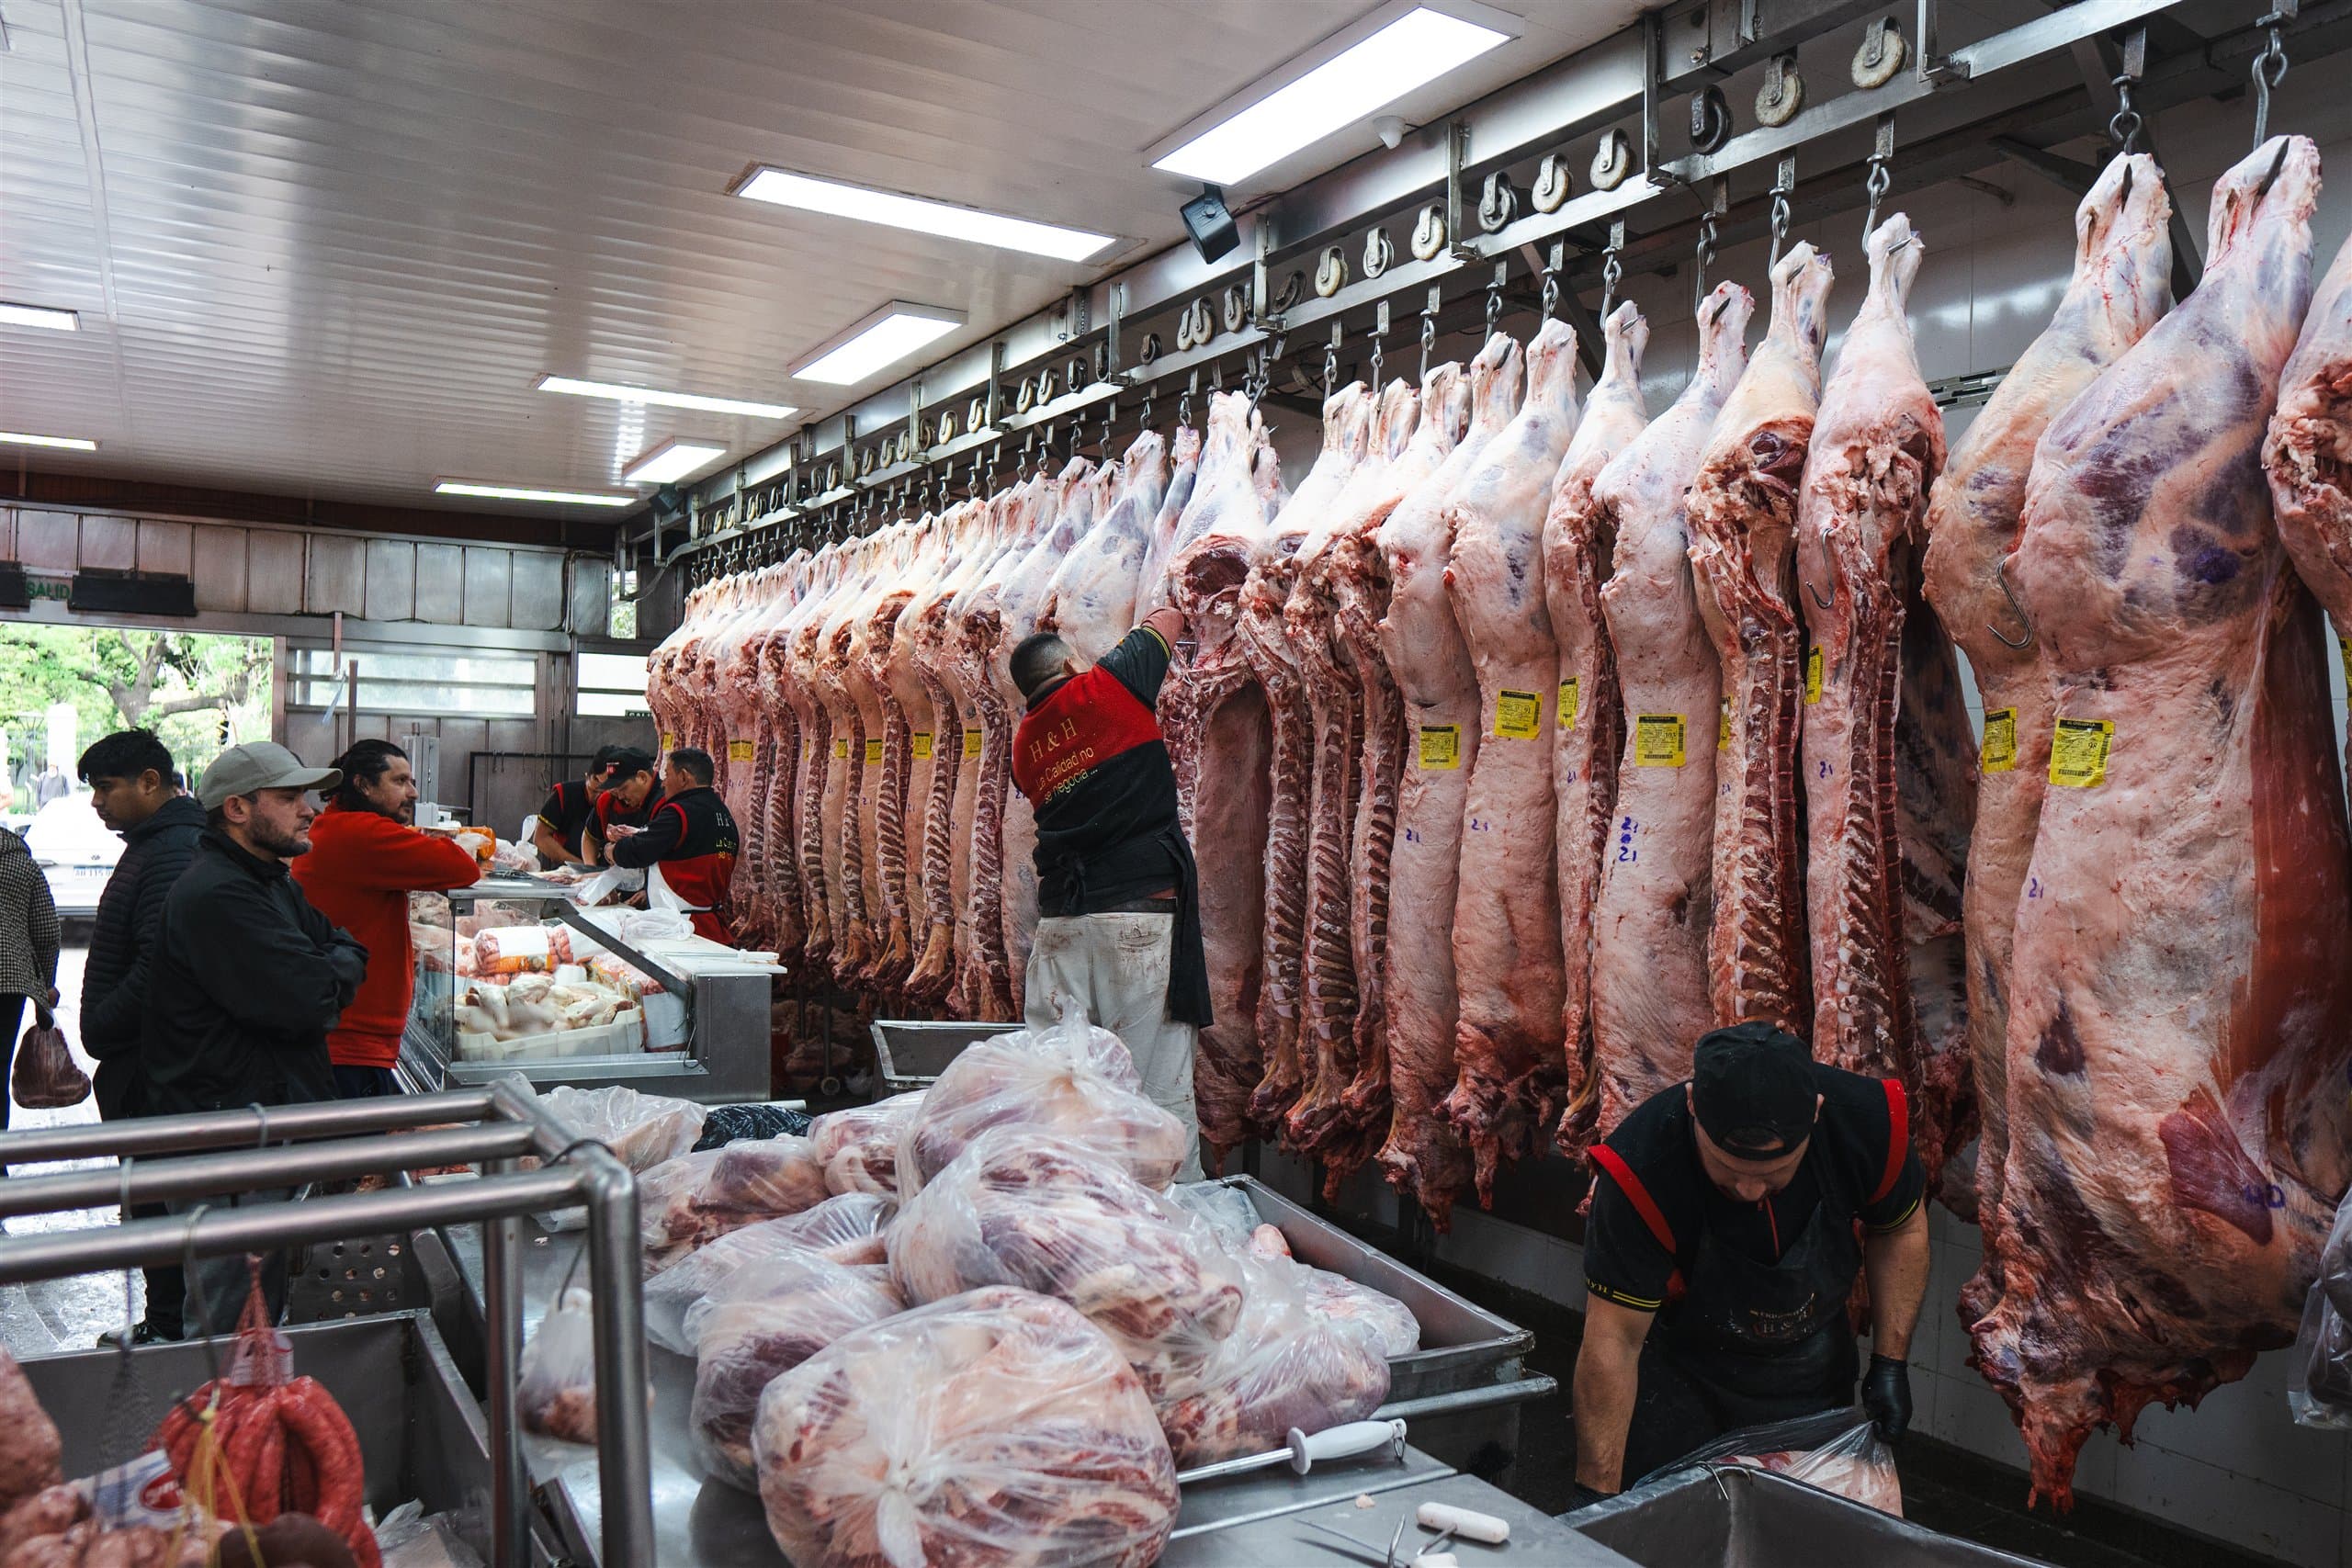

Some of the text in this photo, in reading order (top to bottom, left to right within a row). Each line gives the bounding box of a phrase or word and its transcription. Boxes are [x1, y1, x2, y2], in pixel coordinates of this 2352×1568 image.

[26, 581, 71, 598] SALID
[1029, 718, 1077, 763] H & H
[1046, 751, 1080, 782] Calidad
[1080, 747, 1094, 761] no
[1820, 761, 1833, 779] 21
[1052, 769, 1089, 795] negocia
[1472, 818, 1488, 832] 21
[1406, 829, 1420, 843] 21
[1619, 845, 1637, 863] 21
[2029, 877, 2044, 899] 21
